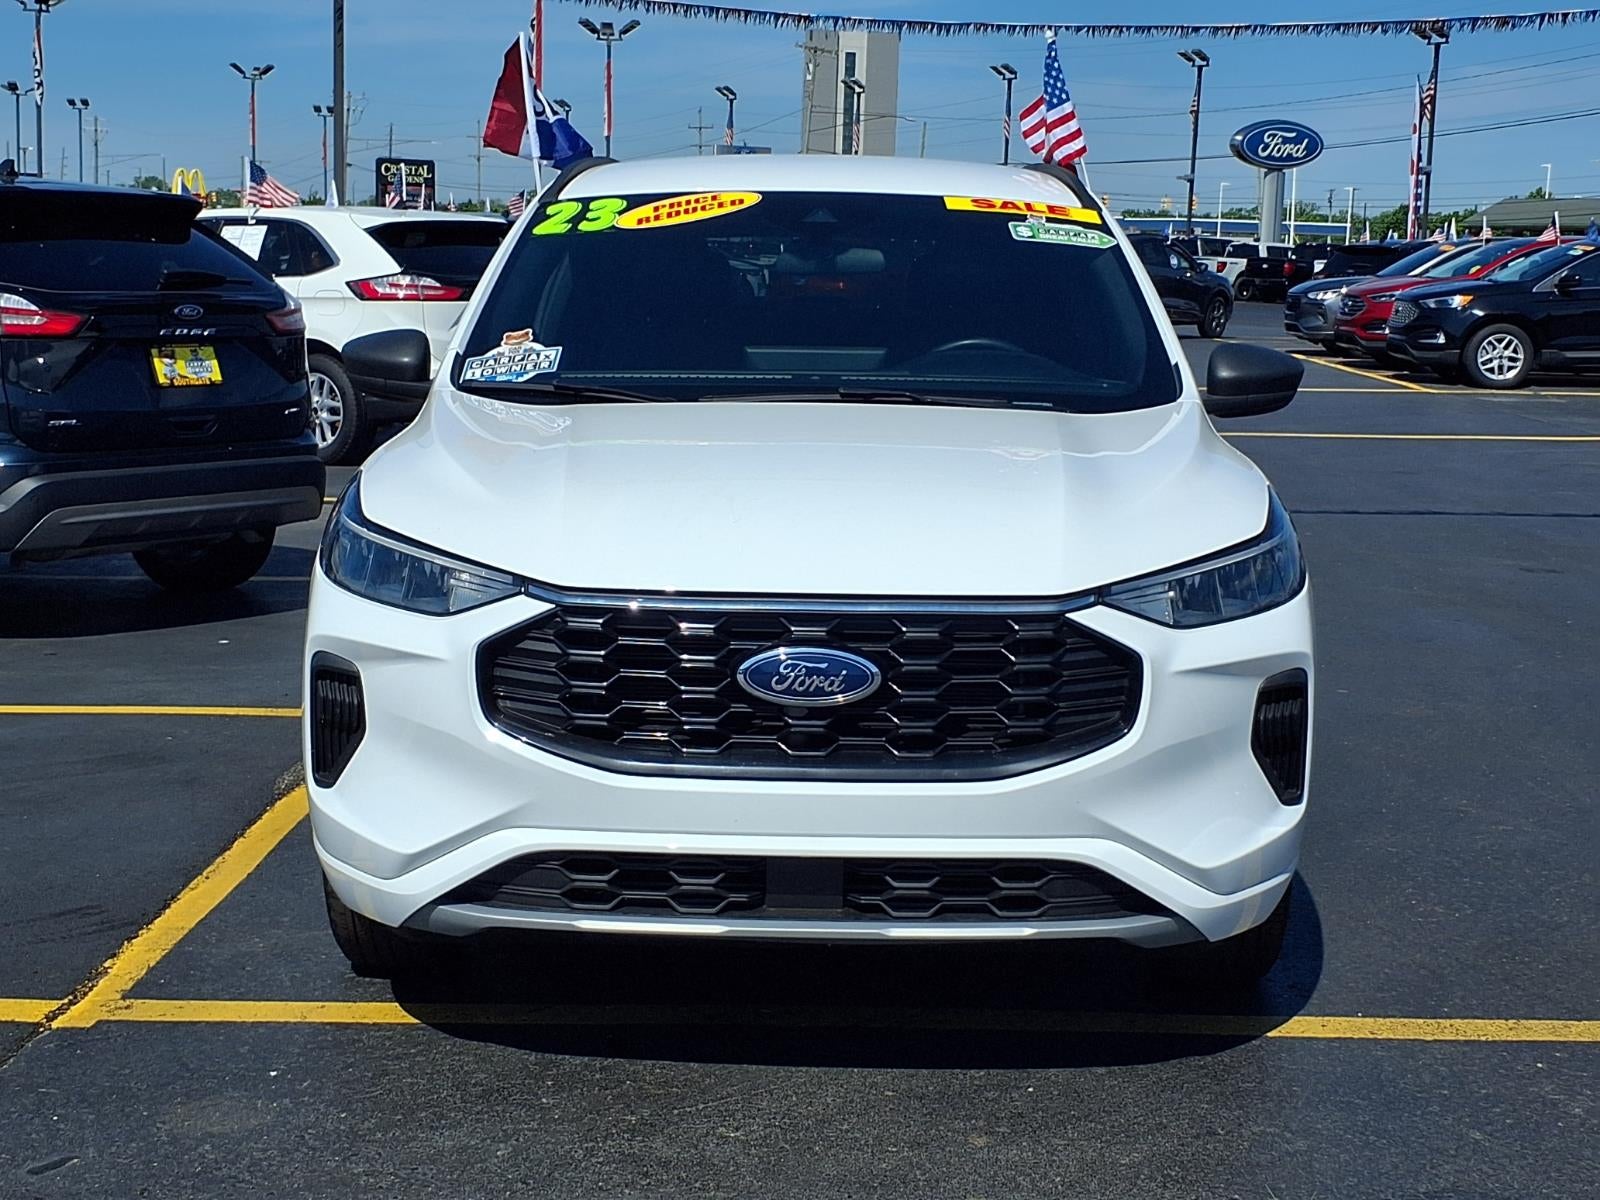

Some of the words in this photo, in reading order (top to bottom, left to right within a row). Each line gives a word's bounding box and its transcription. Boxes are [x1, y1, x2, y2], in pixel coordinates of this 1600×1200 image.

[1258, 130, 1309, 158] Ford
[532, 198, 627, 235] 23
[636, 198, 745, 226] REDUCED
[653, 194, 722, 213] PRICE
[970, 198, 1070, 216] SALE
[471, 353, 552, 368] CARFAX
[771, 659, 847, 692] Ford
